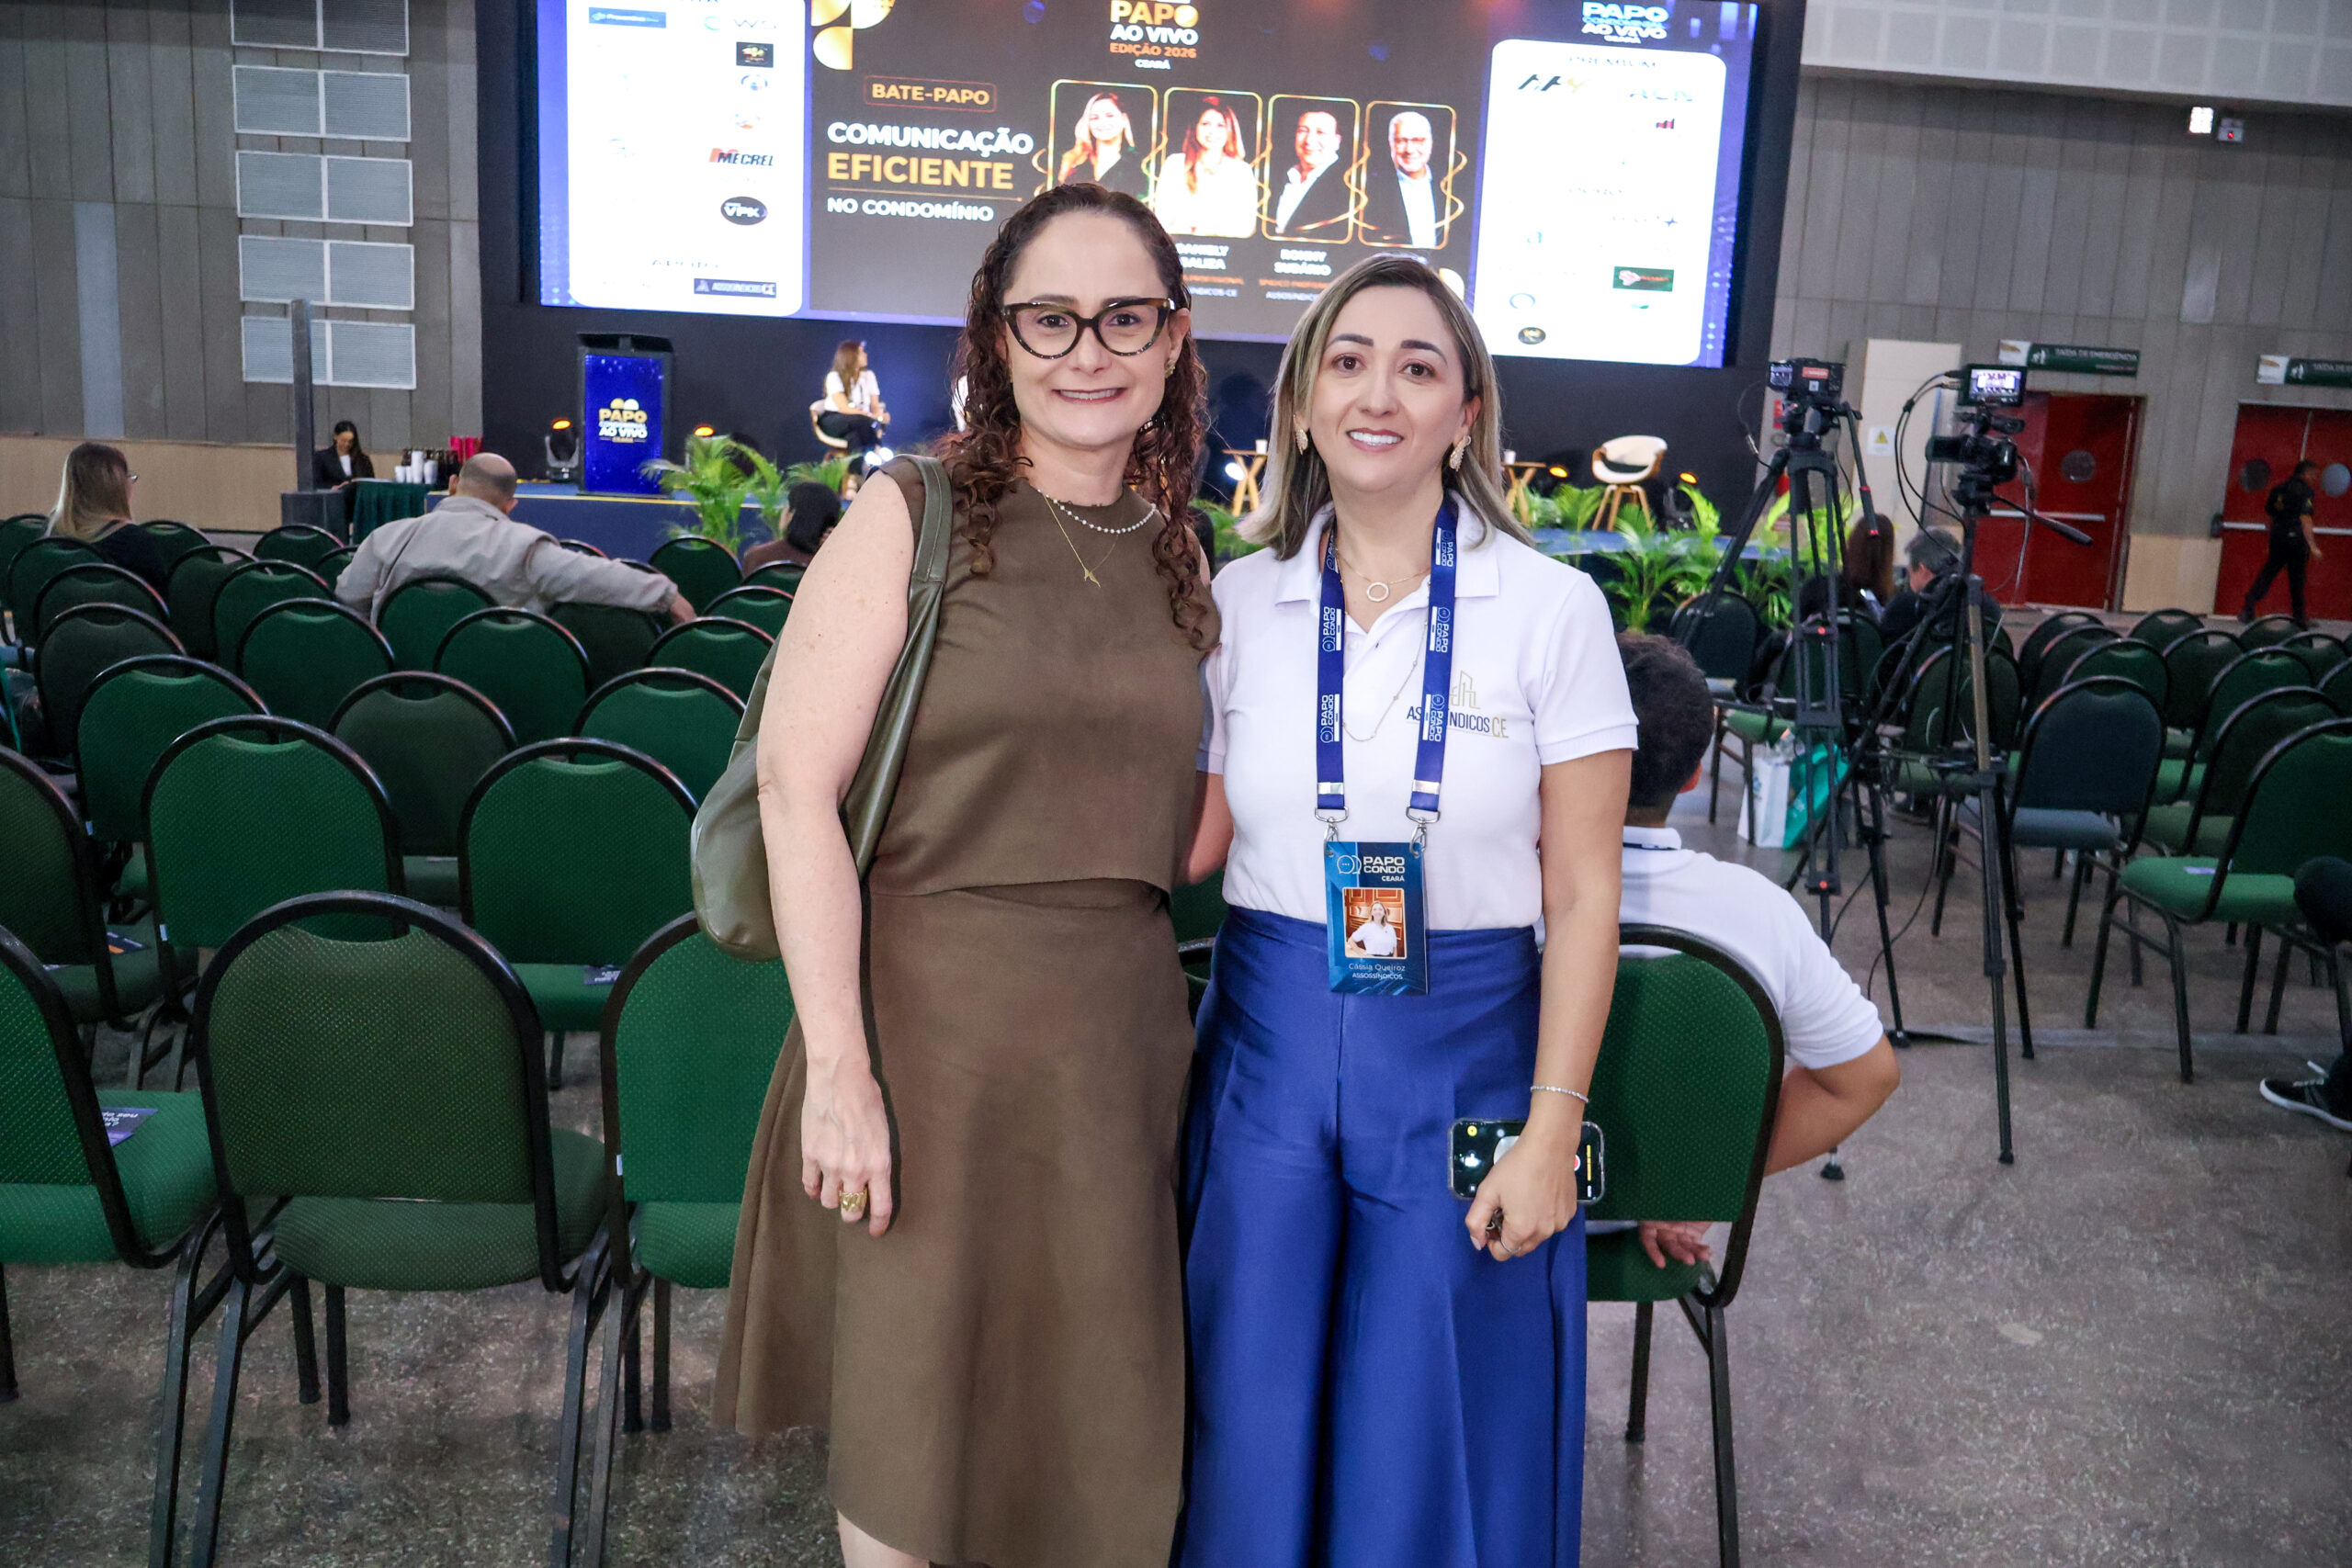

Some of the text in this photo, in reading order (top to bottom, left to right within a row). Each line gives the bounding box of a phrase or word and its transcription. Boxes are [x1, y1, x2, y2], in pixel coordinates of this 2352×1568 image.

[1110, 0, 1199, 28] PAPO
[1582, 1, 1669, 22] PAPO
[1110, 24, 1199, 46] AO VIVO
[1581, 23, 1668, 39] AO VIVO
[1110, 42, 1197, 59] EDIÇÃO 2026
[872, 83, 990, 106] BATE-PAPO
[827, 121, 1035, 157] COMUNICAÇÃO
[828, 152, 1014, 190] EFICIENTE
[827, 197, 994, 221] NO CONDOMÍNIO
[598, 408, 648, 423] PAPO
[598, 426, 649, 439] AO VIVO
[1435, 622, 1443, 652] CONDO
[1441, 623, 1450, 653] PAPO
[1429, 709, 1437, 741] CONDO
[1434, 710, 1443, 742] PAPO
[1363, 856, 1405, 866] PAPO
[1363, 865, 1406, 874] CONDO
[1374, 963, 1406, 972] Queiroz
